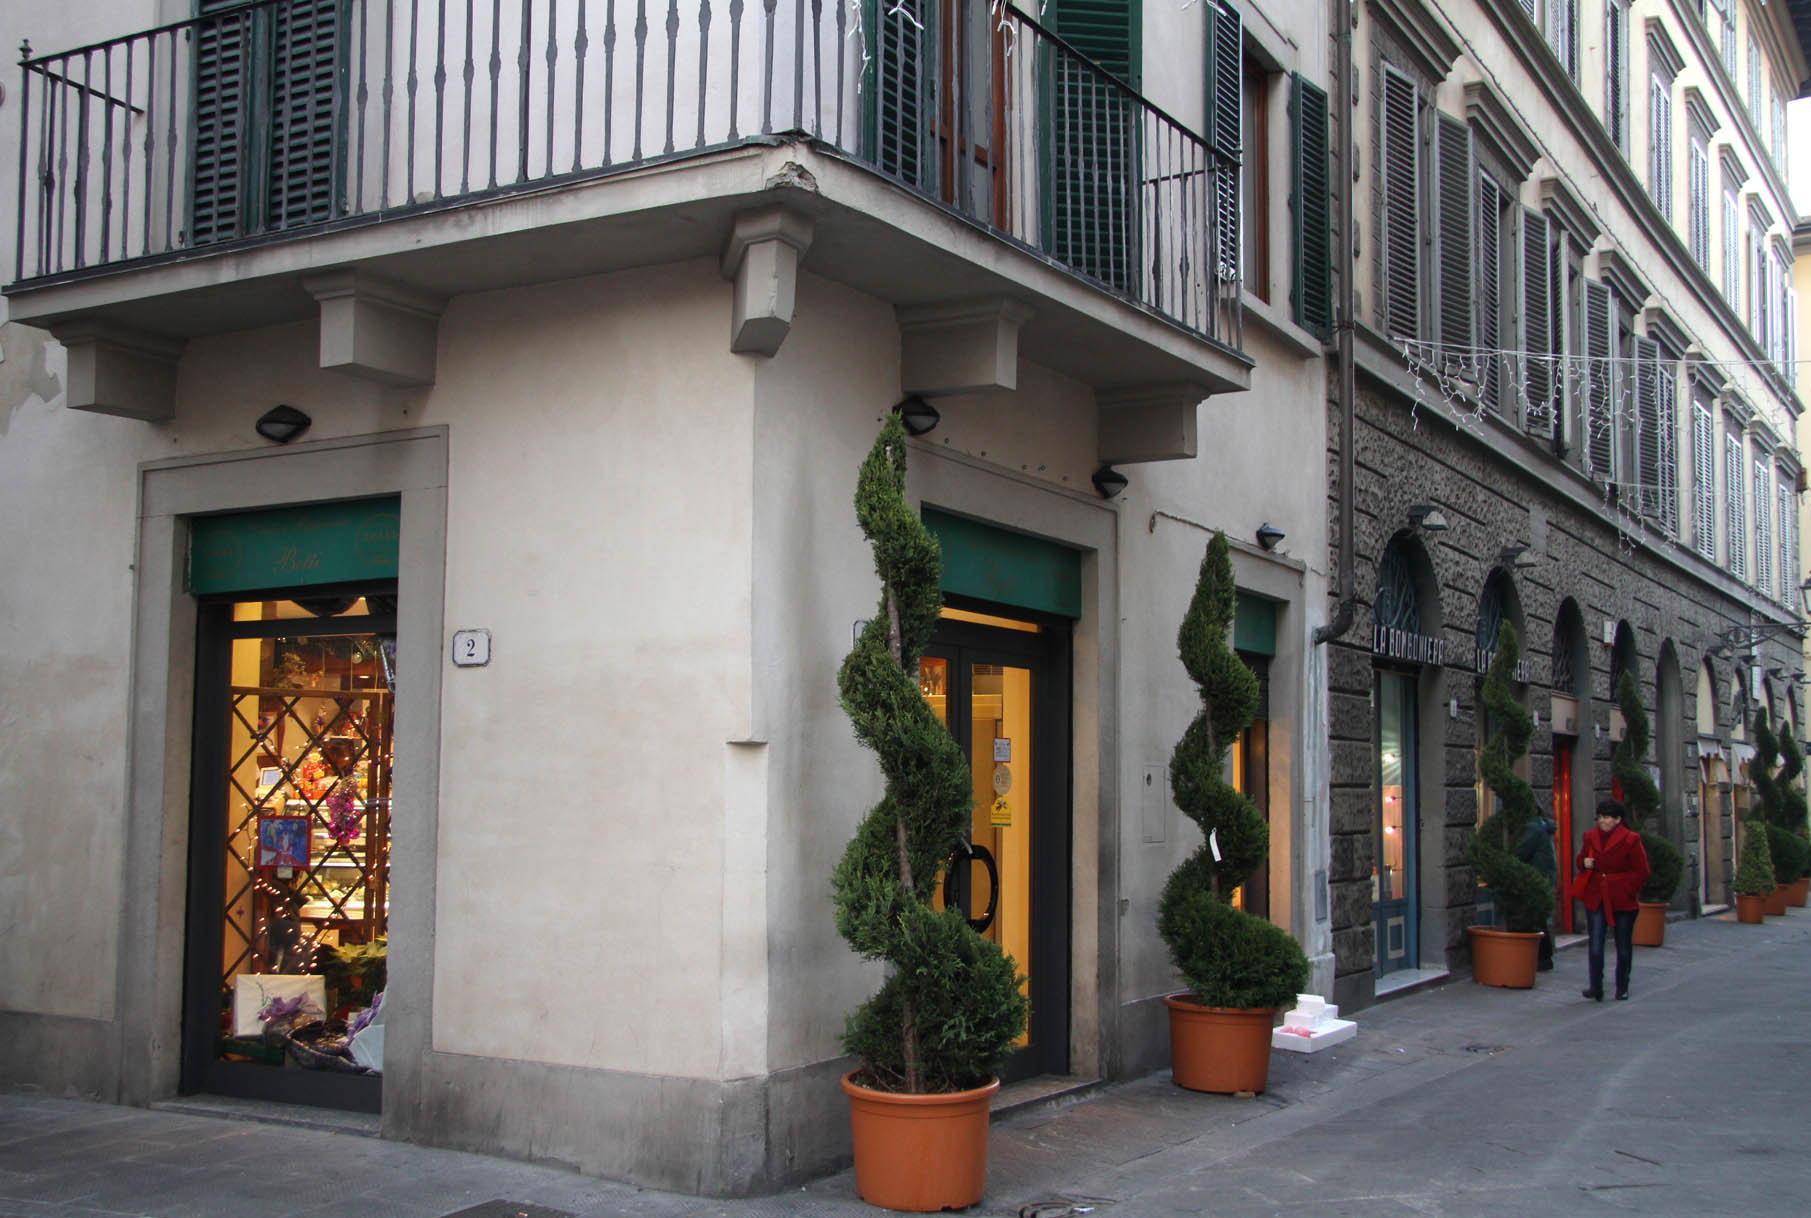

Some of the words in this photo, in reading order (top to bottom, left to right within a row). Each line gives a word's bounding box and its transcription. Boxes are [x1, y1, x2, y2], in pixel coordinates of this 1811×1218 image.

[466, 638, 476, 658] 2
[1373, 623, 1387, 654] LA
[1388, 627, 1444, 665] BOMBONIERA
[1477, 647, 1487, 673] LA
